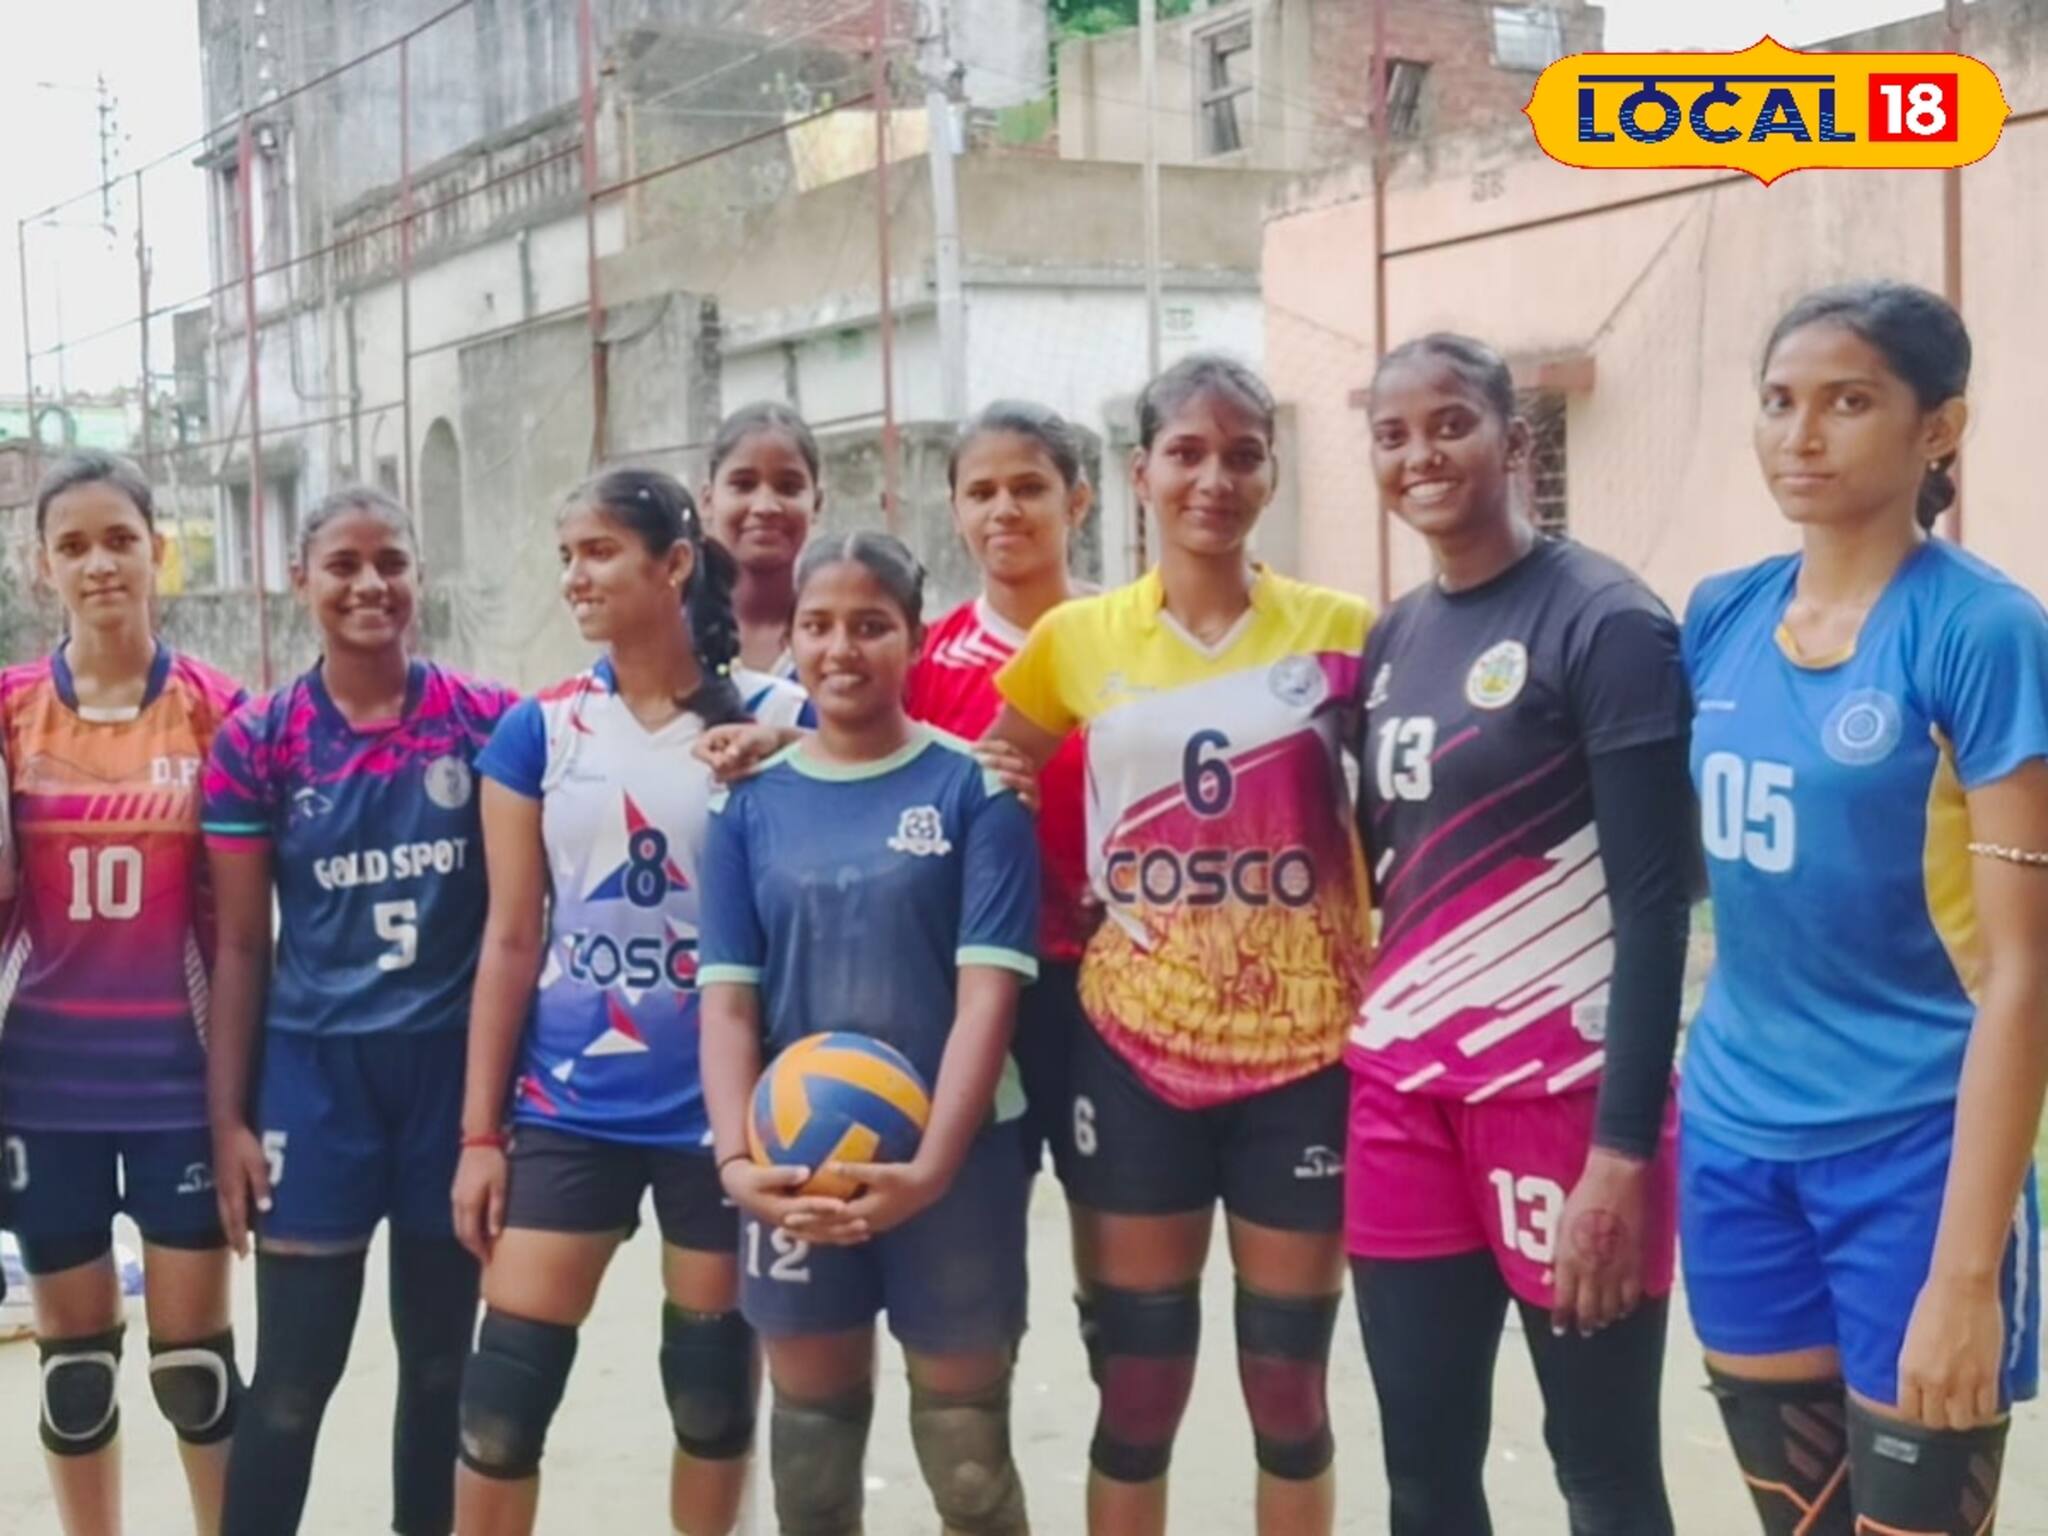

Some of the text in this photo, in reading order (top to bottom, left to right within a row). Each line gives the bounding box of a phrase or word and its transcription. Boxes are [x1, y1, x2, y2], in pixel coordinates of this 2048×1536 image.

[1183, 728, 1233, 816] 6
[1376, 716, 1437, 801] 13
[1701, 751, 1796, 873] 05
[68, 845, 143, 921] 10
[391, 837, 468, 881] SPOT
[626, 827, 668, 909] 8
[1106, 849, 1316, 908] COSCO
[373, 899, 418, 972] 5
[261, 1129, 288, 1186] 5
[1073, 1095, 1097, 1156] 6
[745, 1220, 812, 1283] 12
[1487, 1167, 1566, 1265] 13
